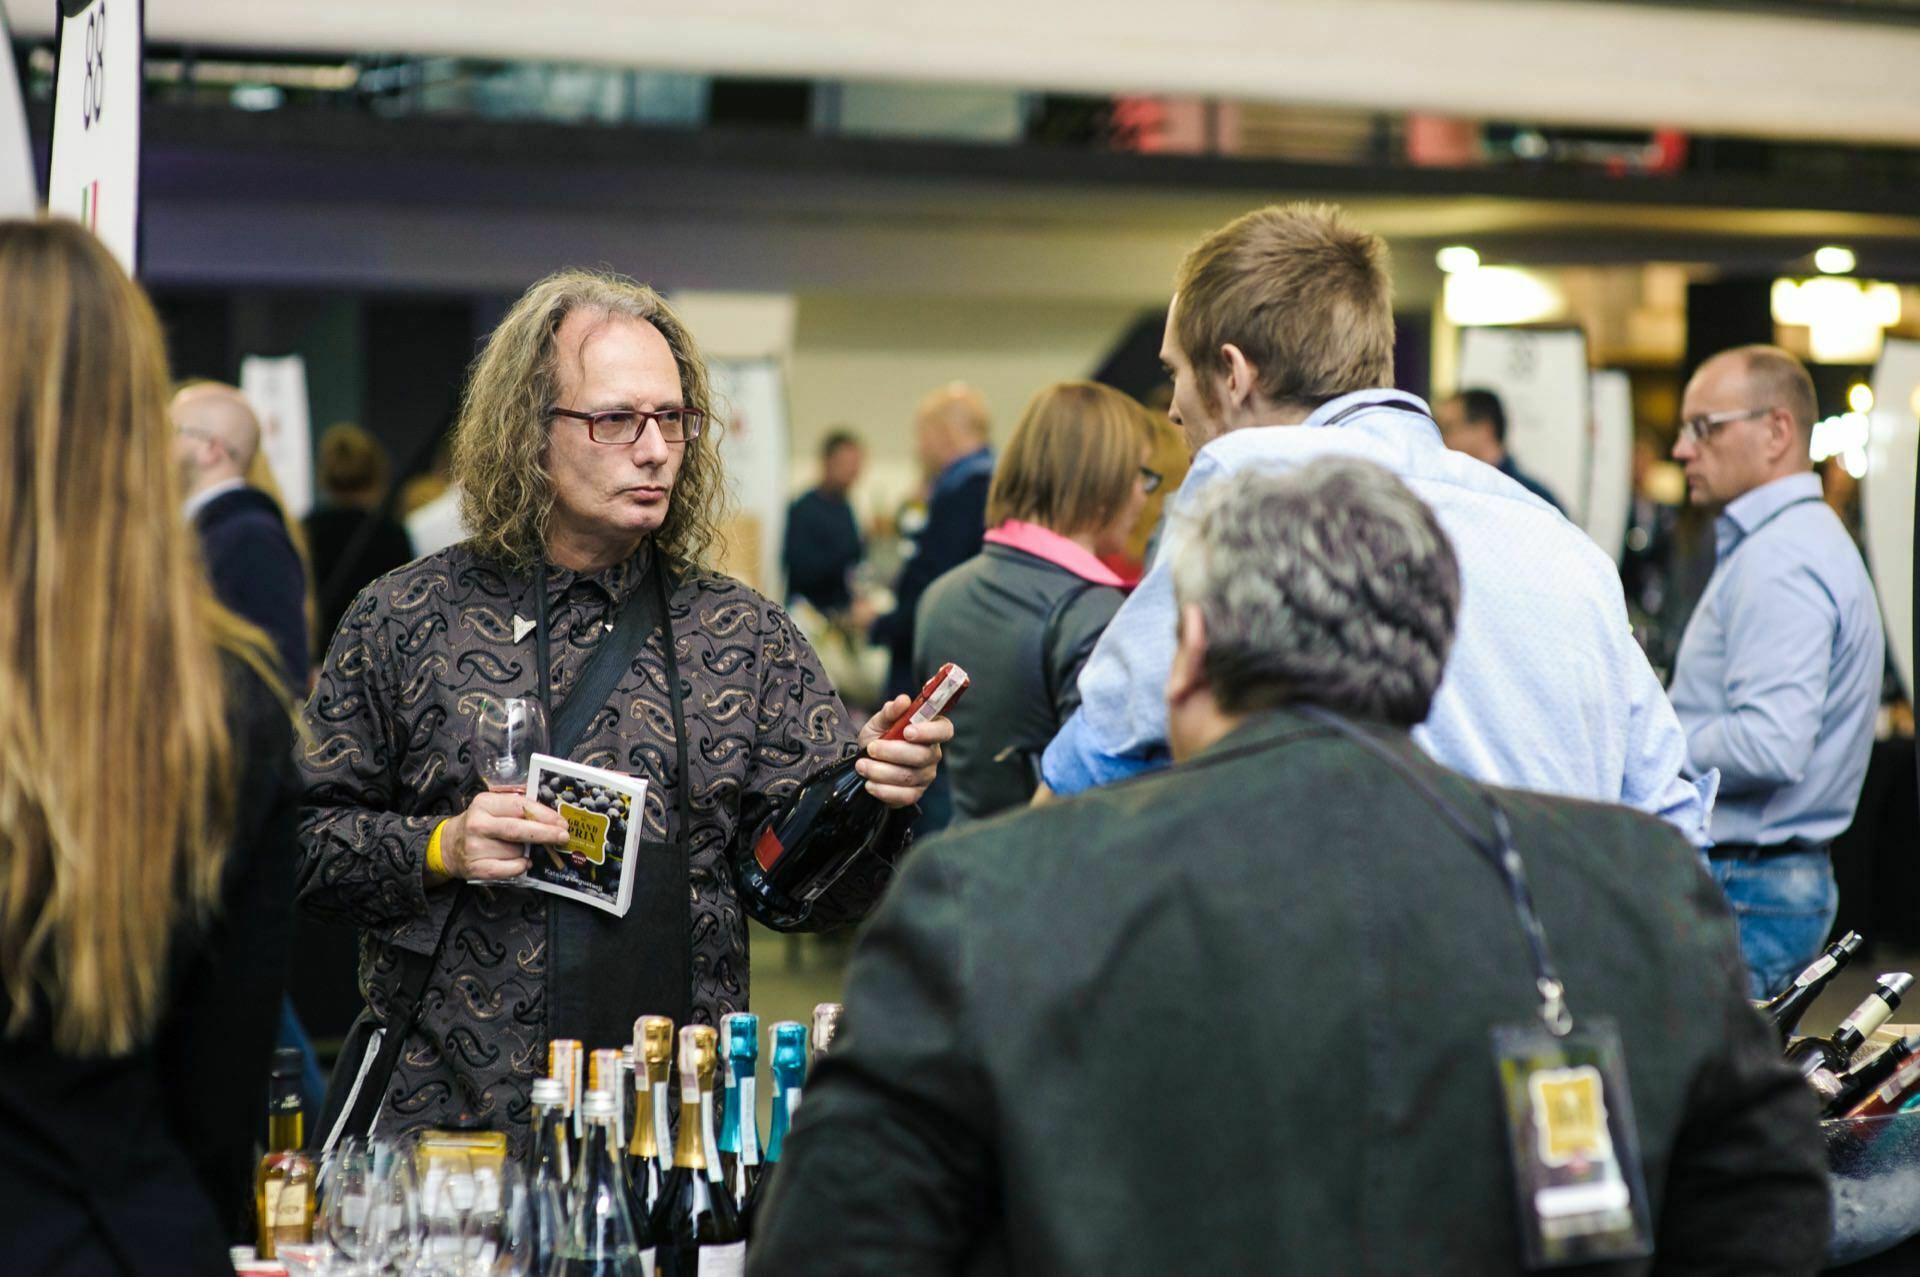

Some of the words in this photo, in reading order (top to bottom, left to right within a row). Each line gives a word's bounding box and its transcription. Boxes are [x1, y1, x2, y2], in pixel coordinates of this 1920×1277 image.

[83, 1, 106, 131] 88
[568, 818, 598, 834] GRAND
[568, 826, 596, 843] PRIX
